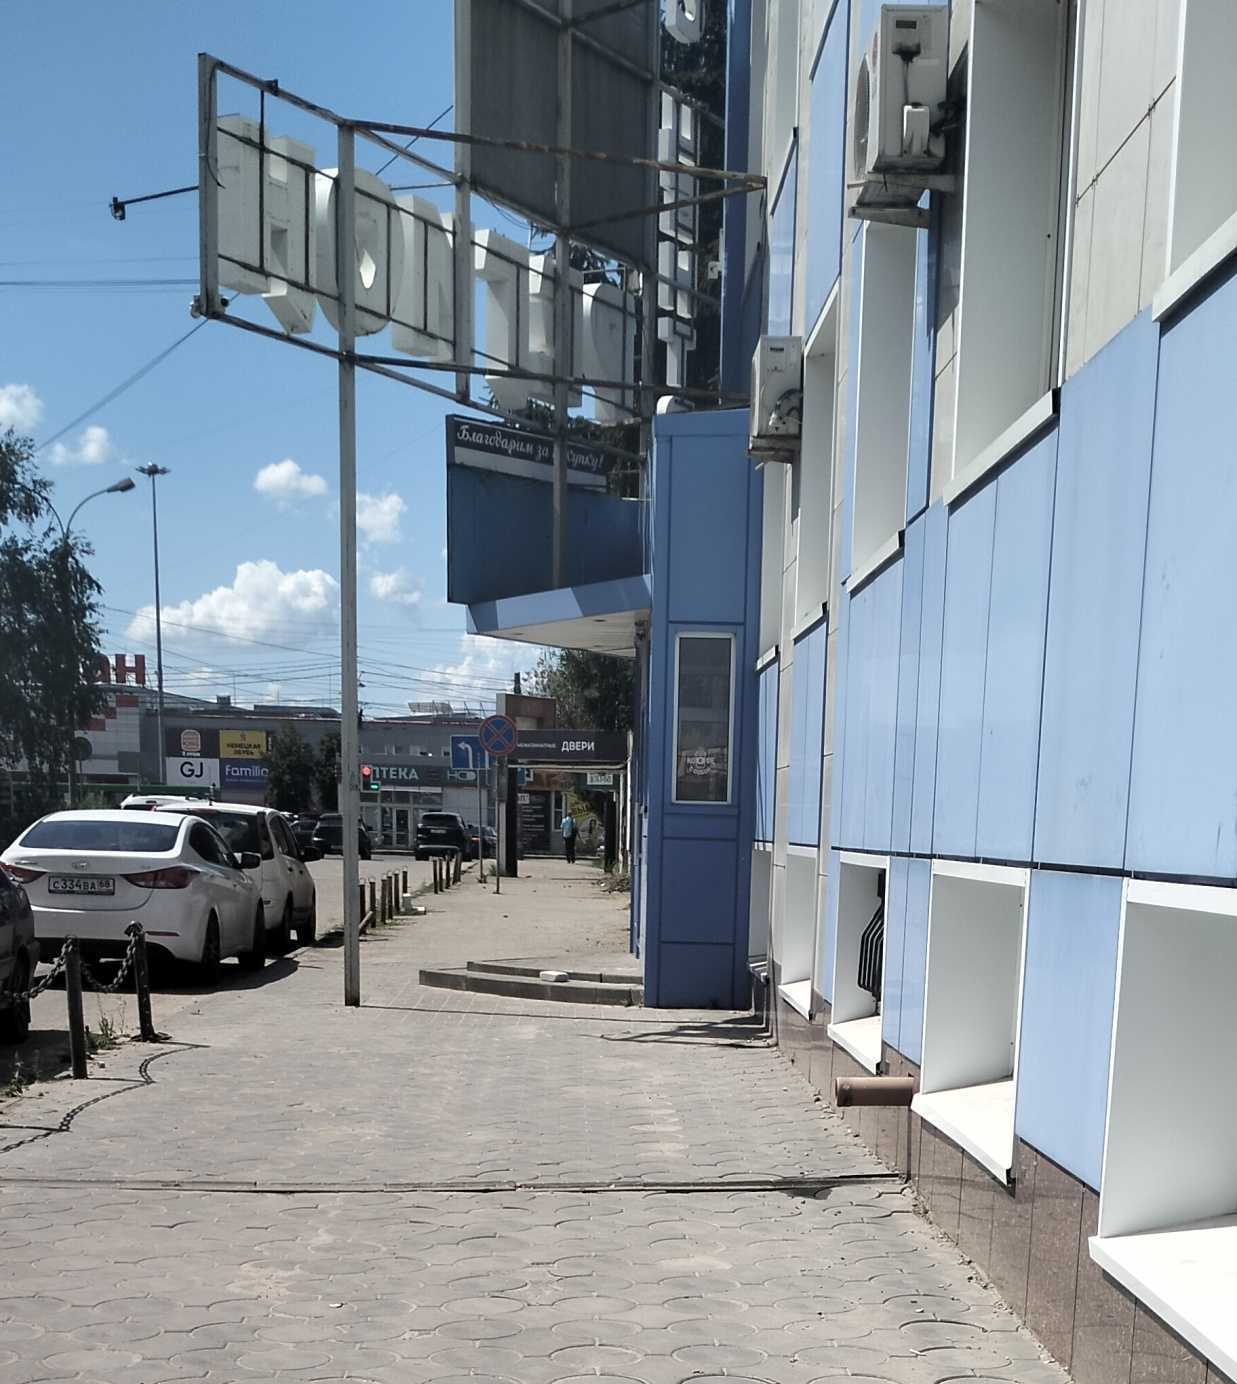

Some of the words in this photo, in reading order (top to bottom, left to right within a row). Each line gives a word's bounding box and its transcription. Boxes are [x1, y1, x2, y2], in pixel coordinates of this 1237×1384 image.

[457, 425, 534, 455] Благодарим
[536, 446, 549, 461] за
[561, 740, 595, 752] ДВЕРИ
[180, 761, 203, 778] GJ
